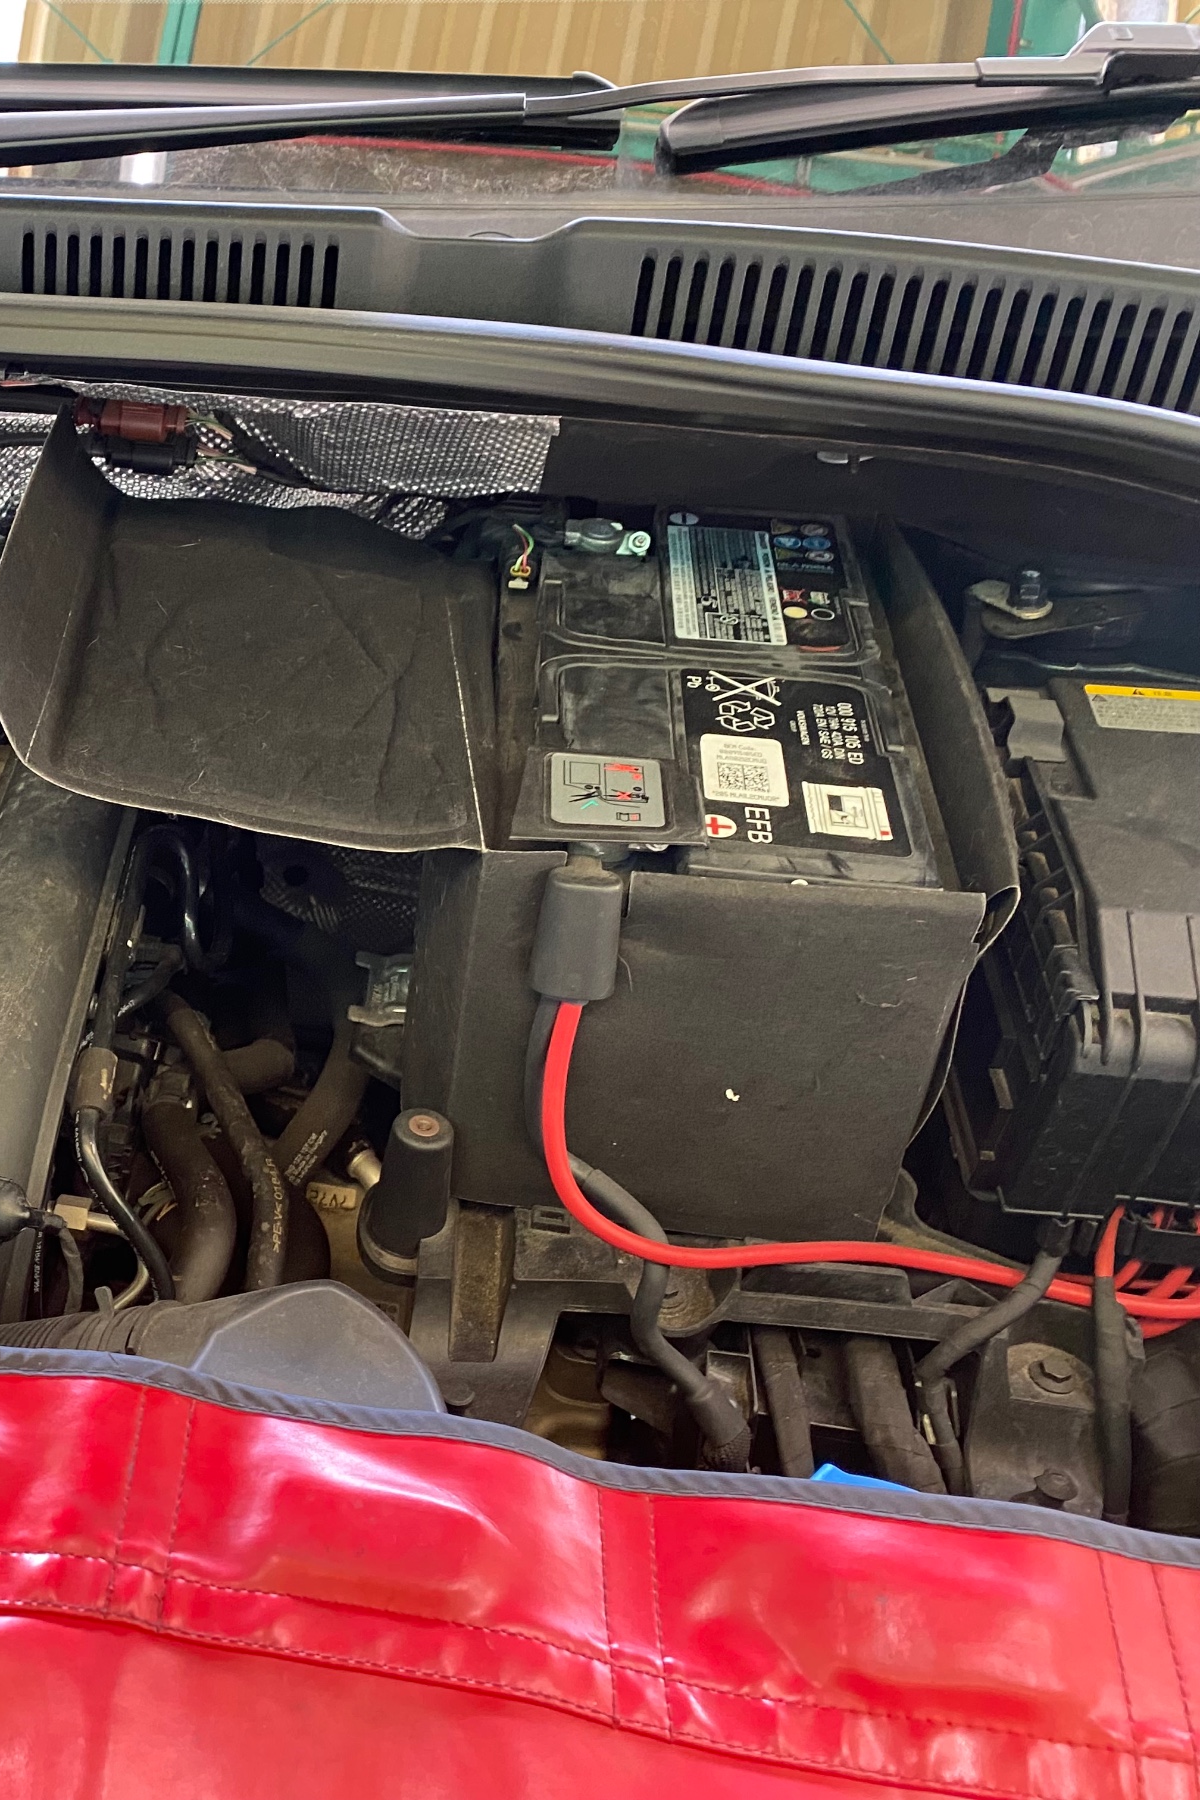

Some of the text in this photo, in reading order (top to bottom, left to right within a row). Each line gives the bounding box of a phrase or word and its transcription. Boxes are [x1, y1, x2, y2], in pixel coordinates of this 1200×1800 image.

[686, 675, 703, 689] Pb
[837, 703, 854, 716] 000
[796, 710, 810, 745] VOLKSWAGEN
[841, 718, 858, 732] 915
[833, 747, 845, 760] DIN
[848, 752, 864, 765] ED
[744, 806, 773, 844] EFB
